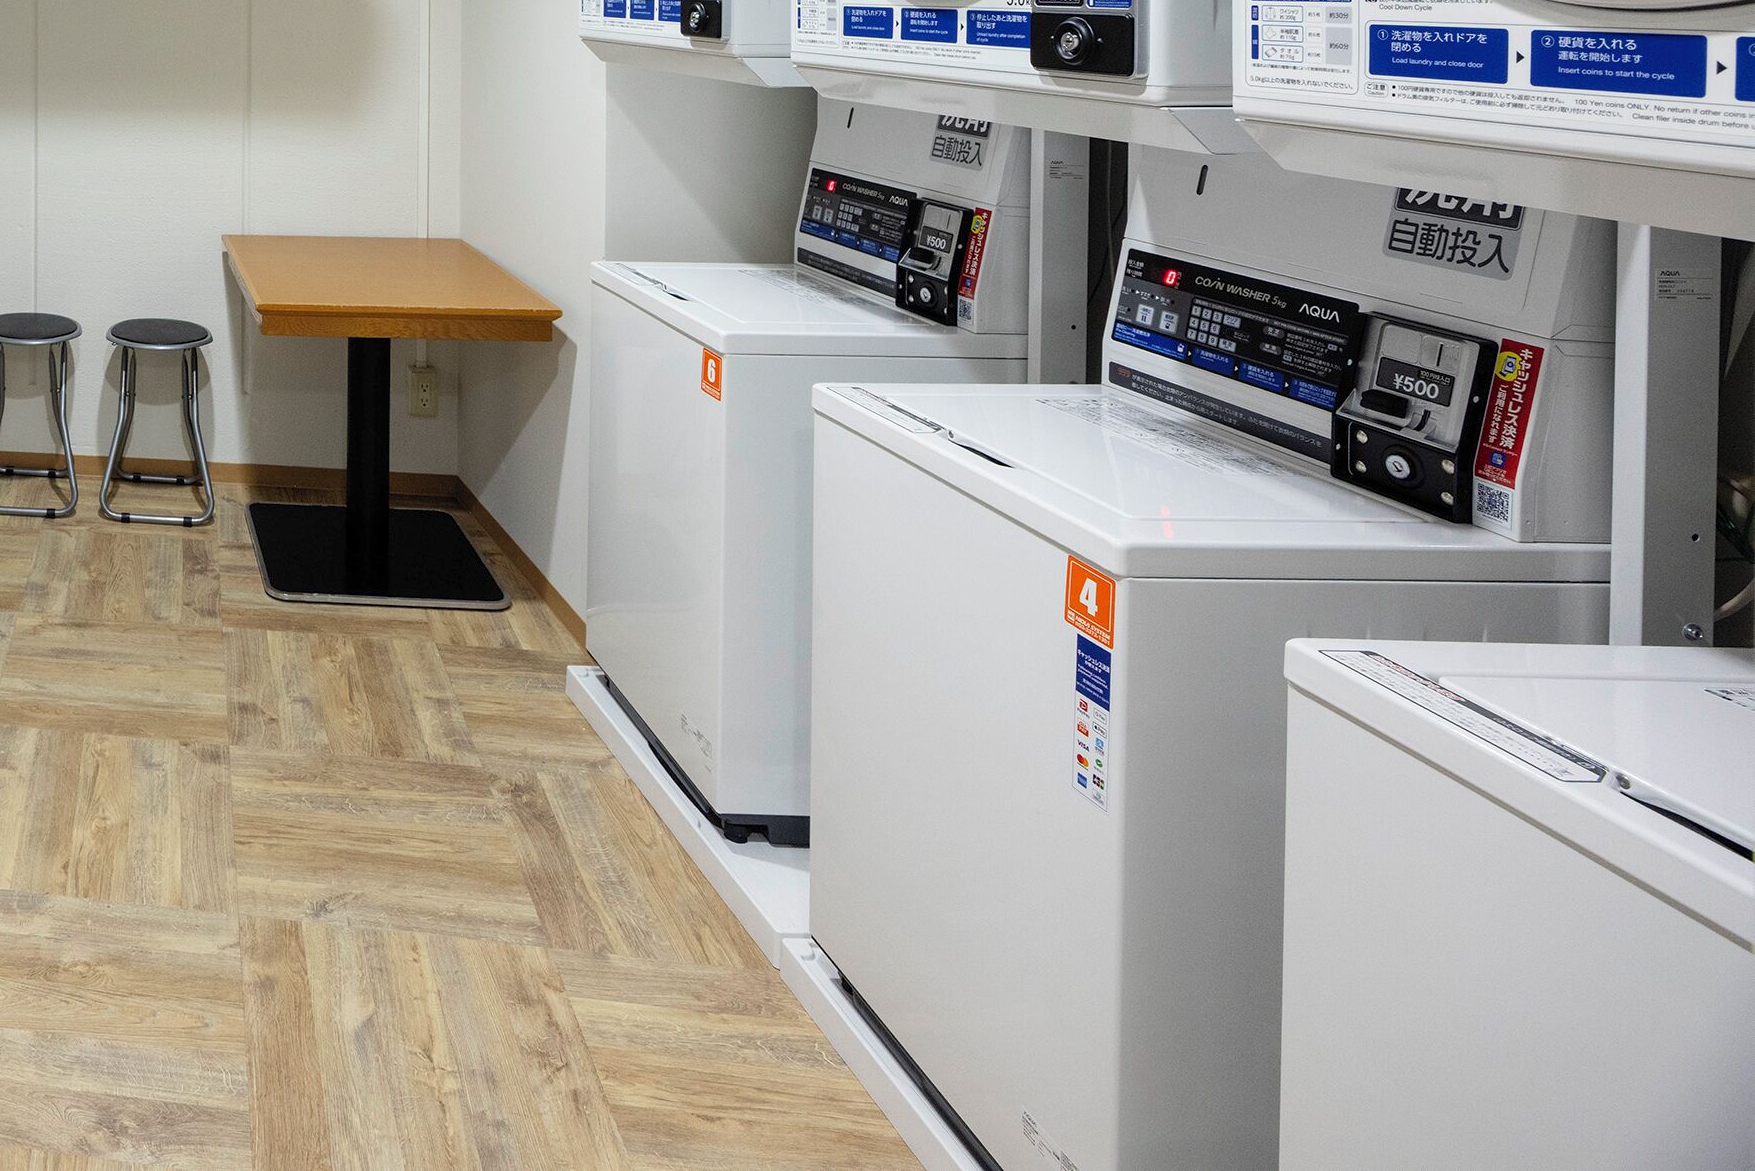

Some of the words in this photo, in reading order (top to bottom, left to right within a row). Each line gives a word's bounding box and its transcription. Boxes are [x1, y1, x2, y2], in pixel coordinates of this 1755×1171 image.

[1414, 4, 1433, 12] Cycle
[1391, 30, 1488, 45] 洗濯物を入れドアを
[1558, 36, 1637, 51] 硬貨を入れる
[1391, 42, 1422, 53] 閉める
[1557, 51, 1643, 65] 運転を開始します
[1574, 98, 1588, 106] 100
[1589, 99, 1603, 108] Yen
[1605, 101, 1626, 109] coins
[1653, 104, 1666, 112] No
[932, 135, 982, 166] 自動投入
[926, 235, 946, 250] ¥500
[1388, 218, 1509, 273] 自動投入
[1166, 271, 1177, 286] 0
[1226, 284, 1271, 303] WASHER
[1271, 295, 1287, 309] 5kg
[1299, 303, 1340, 323] AQUA
[707, 358, 717, 383] 6
[1393, 373, 1439, 400] ¥500
[1500, 348, 1533, 450] キャッシュレス決済
[1079, 577, 1099, 617] 4
